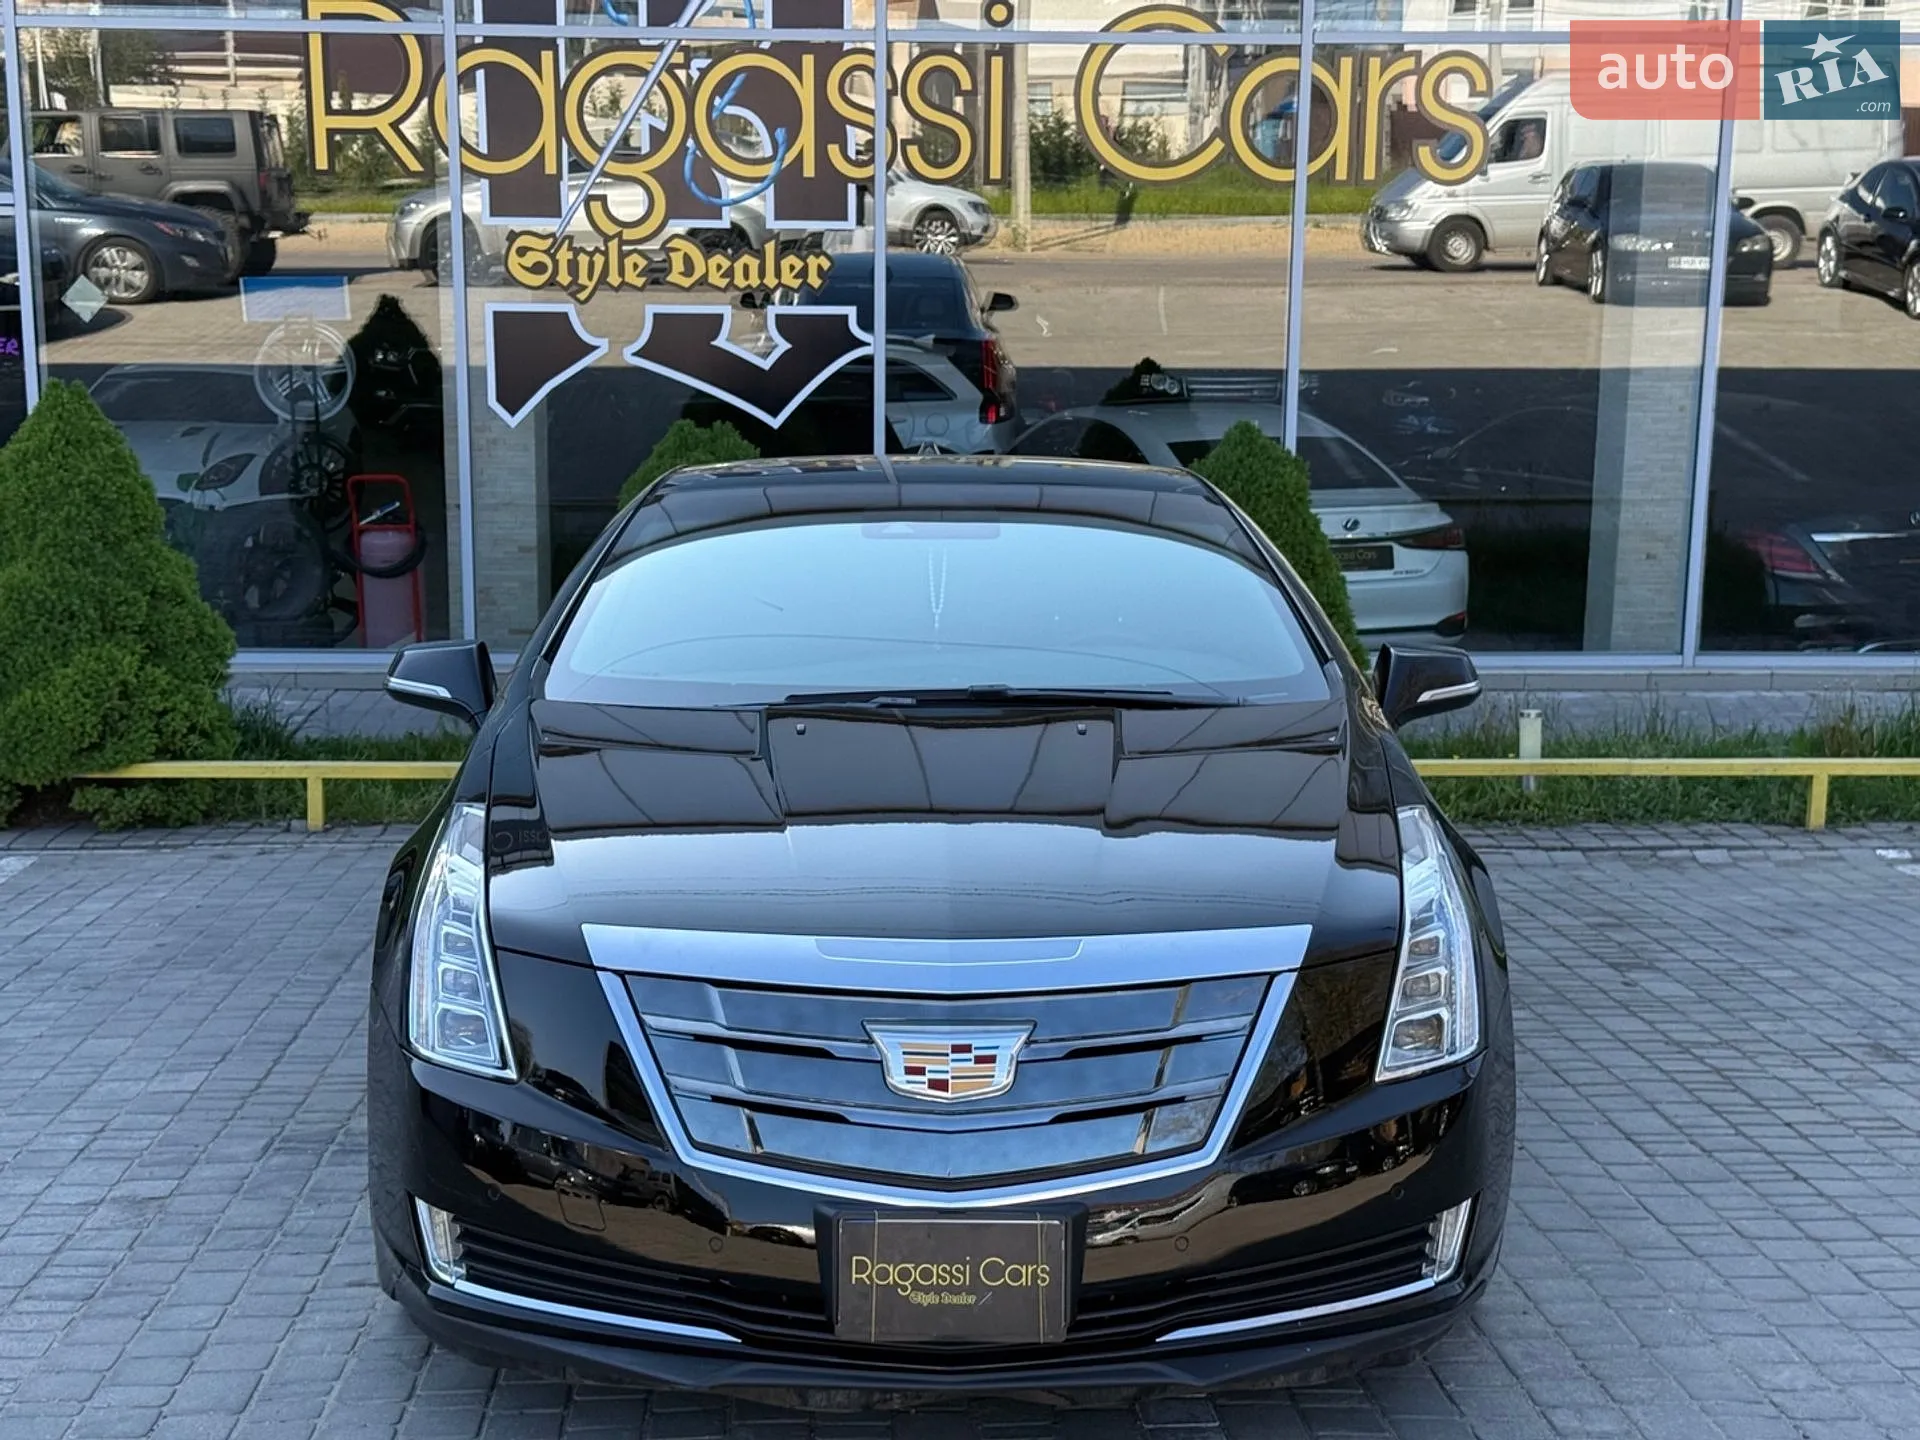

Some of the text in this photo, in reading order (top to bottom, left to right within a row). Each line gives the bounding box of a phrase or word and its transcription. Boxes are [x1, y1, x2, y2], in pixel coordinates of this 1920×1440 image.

[304, 0, 1491, 243] Ragassi Cars
[505, 230, 834, 303] Style Dealer
[851, 1256, 1050, 1296] Ragassi Cars
